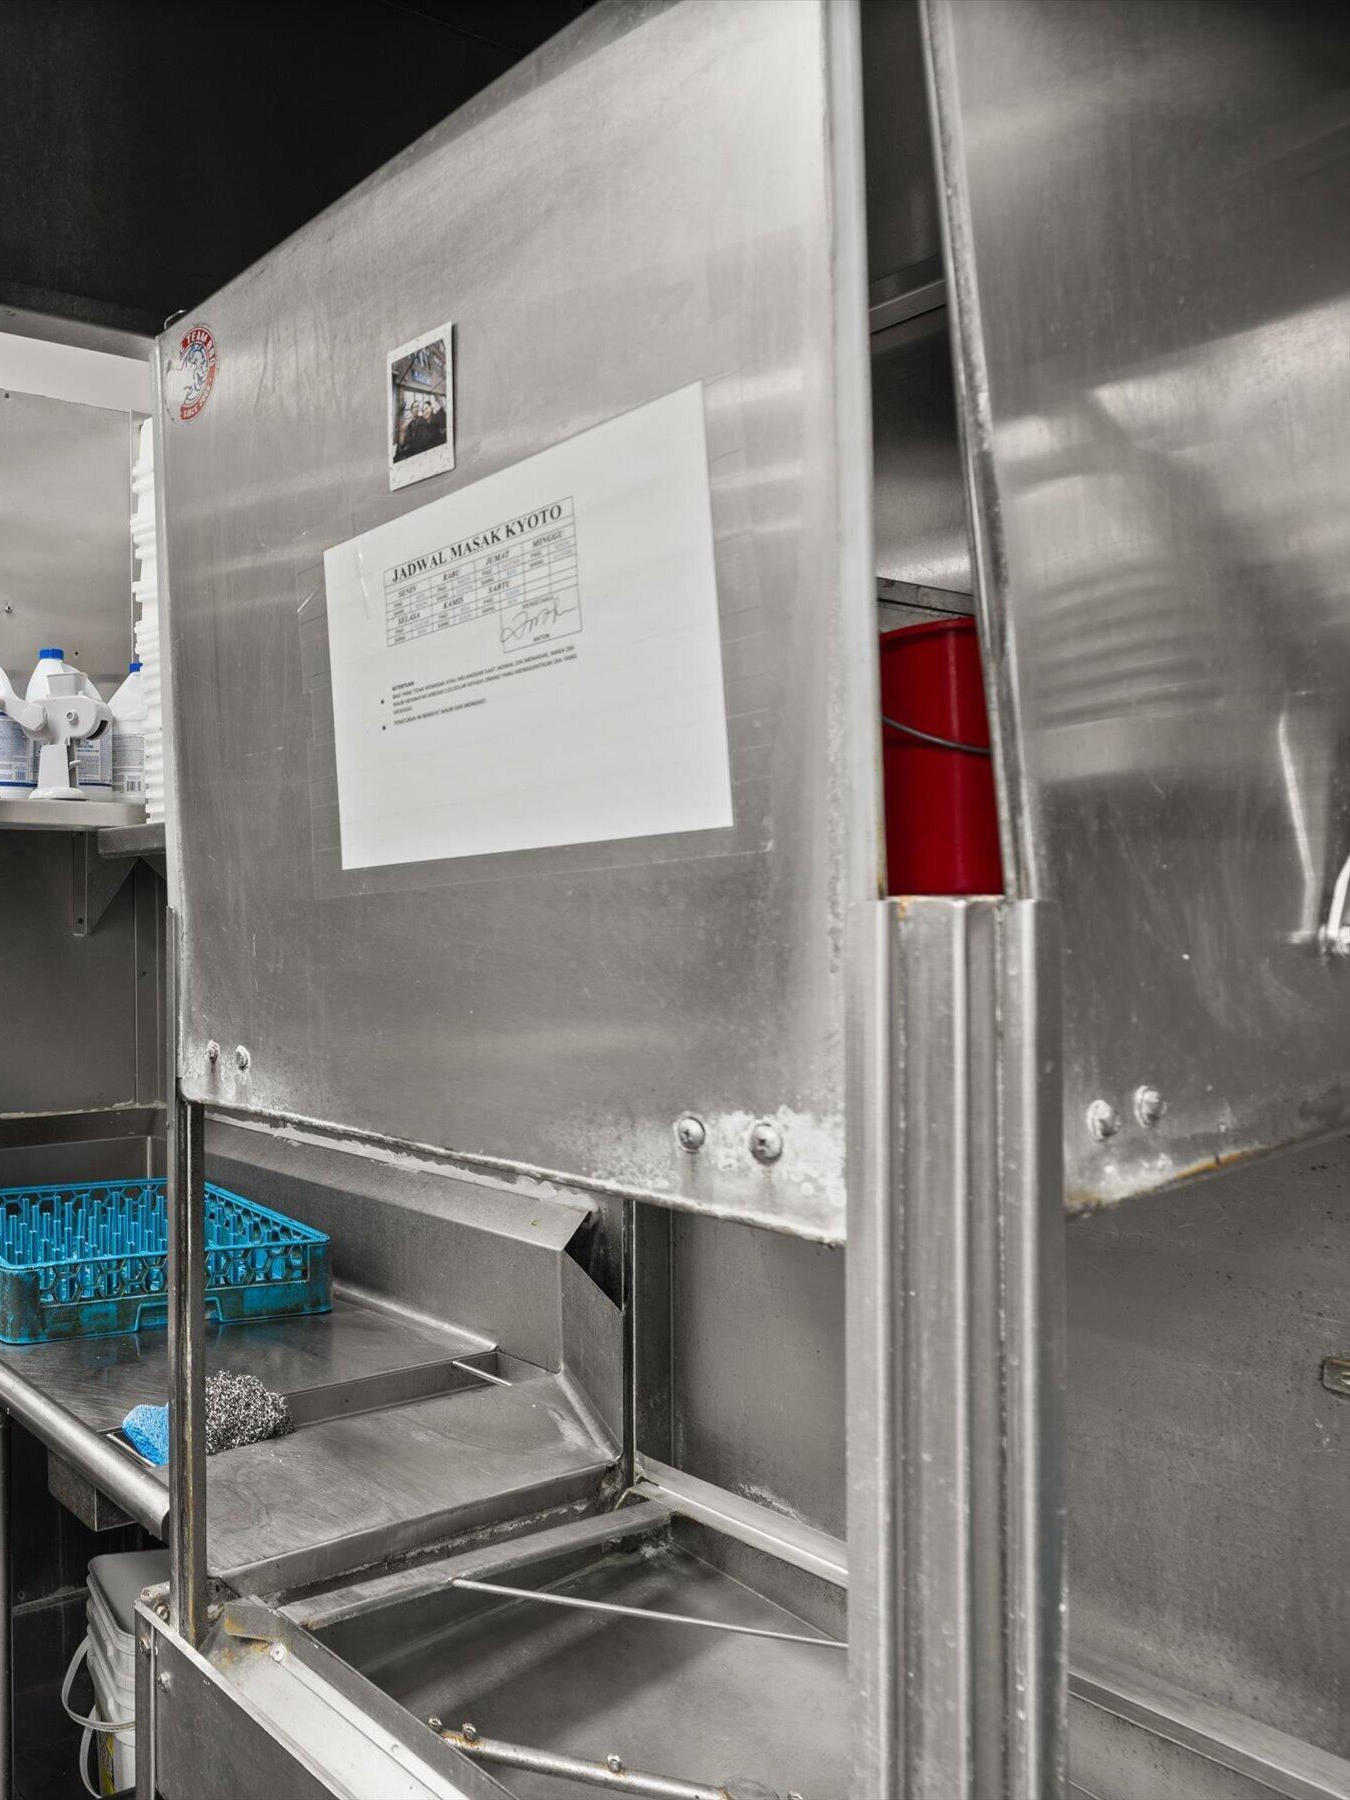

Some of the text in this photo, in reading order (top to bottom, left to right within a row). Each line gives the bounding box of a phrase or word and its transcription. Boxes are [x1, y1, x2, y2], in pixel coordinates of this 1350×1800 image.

[392, 554, 446, 582] JADWAL
[450, 528, 501, 560] MASAK
[505, 504, 561, 538] KYOTO
